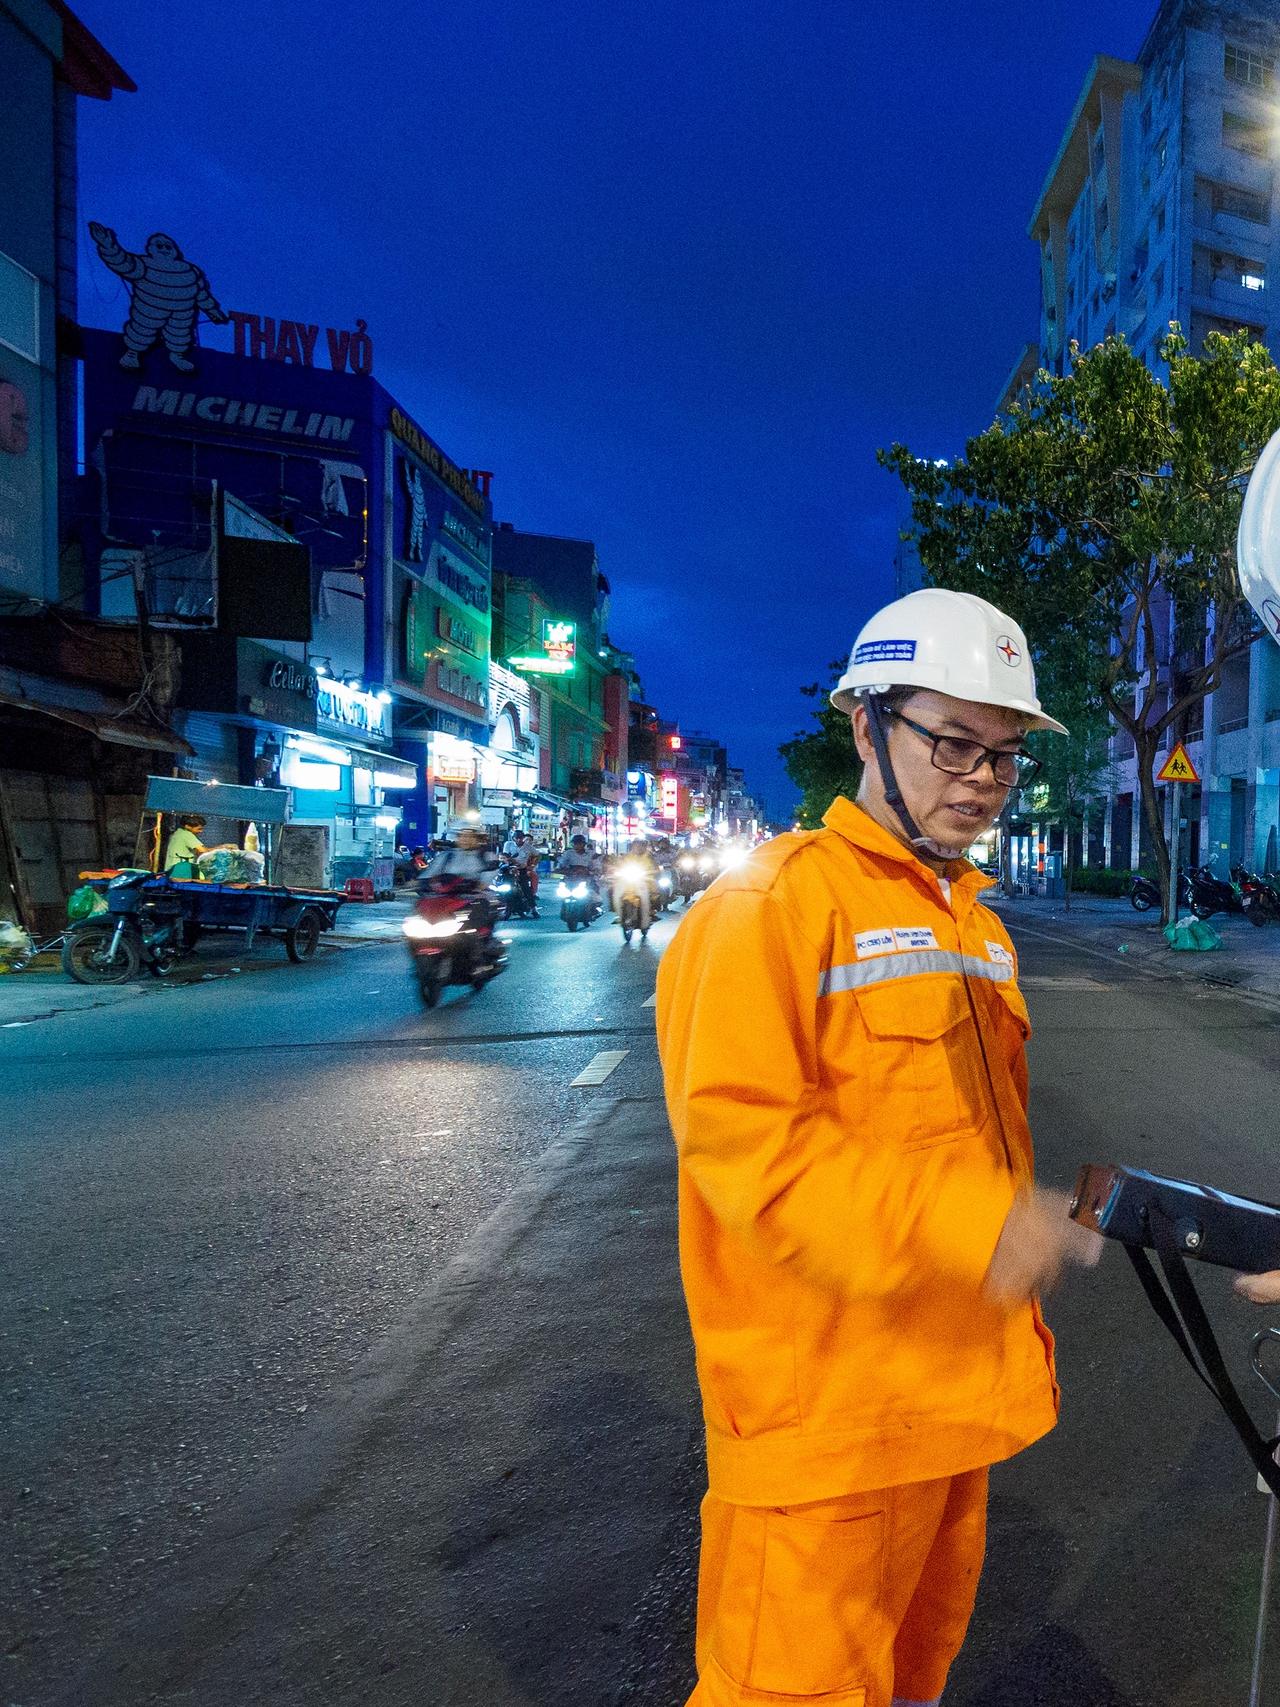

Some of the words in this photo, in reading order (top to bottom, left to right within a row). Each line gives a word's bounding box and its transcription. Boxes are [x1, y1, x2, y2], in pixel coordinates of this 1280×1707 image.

[229, 311, 319, 368] THAY
[326, 319, 372, 376] VỎ
[132, 385, 355, 442] MICHELIN
